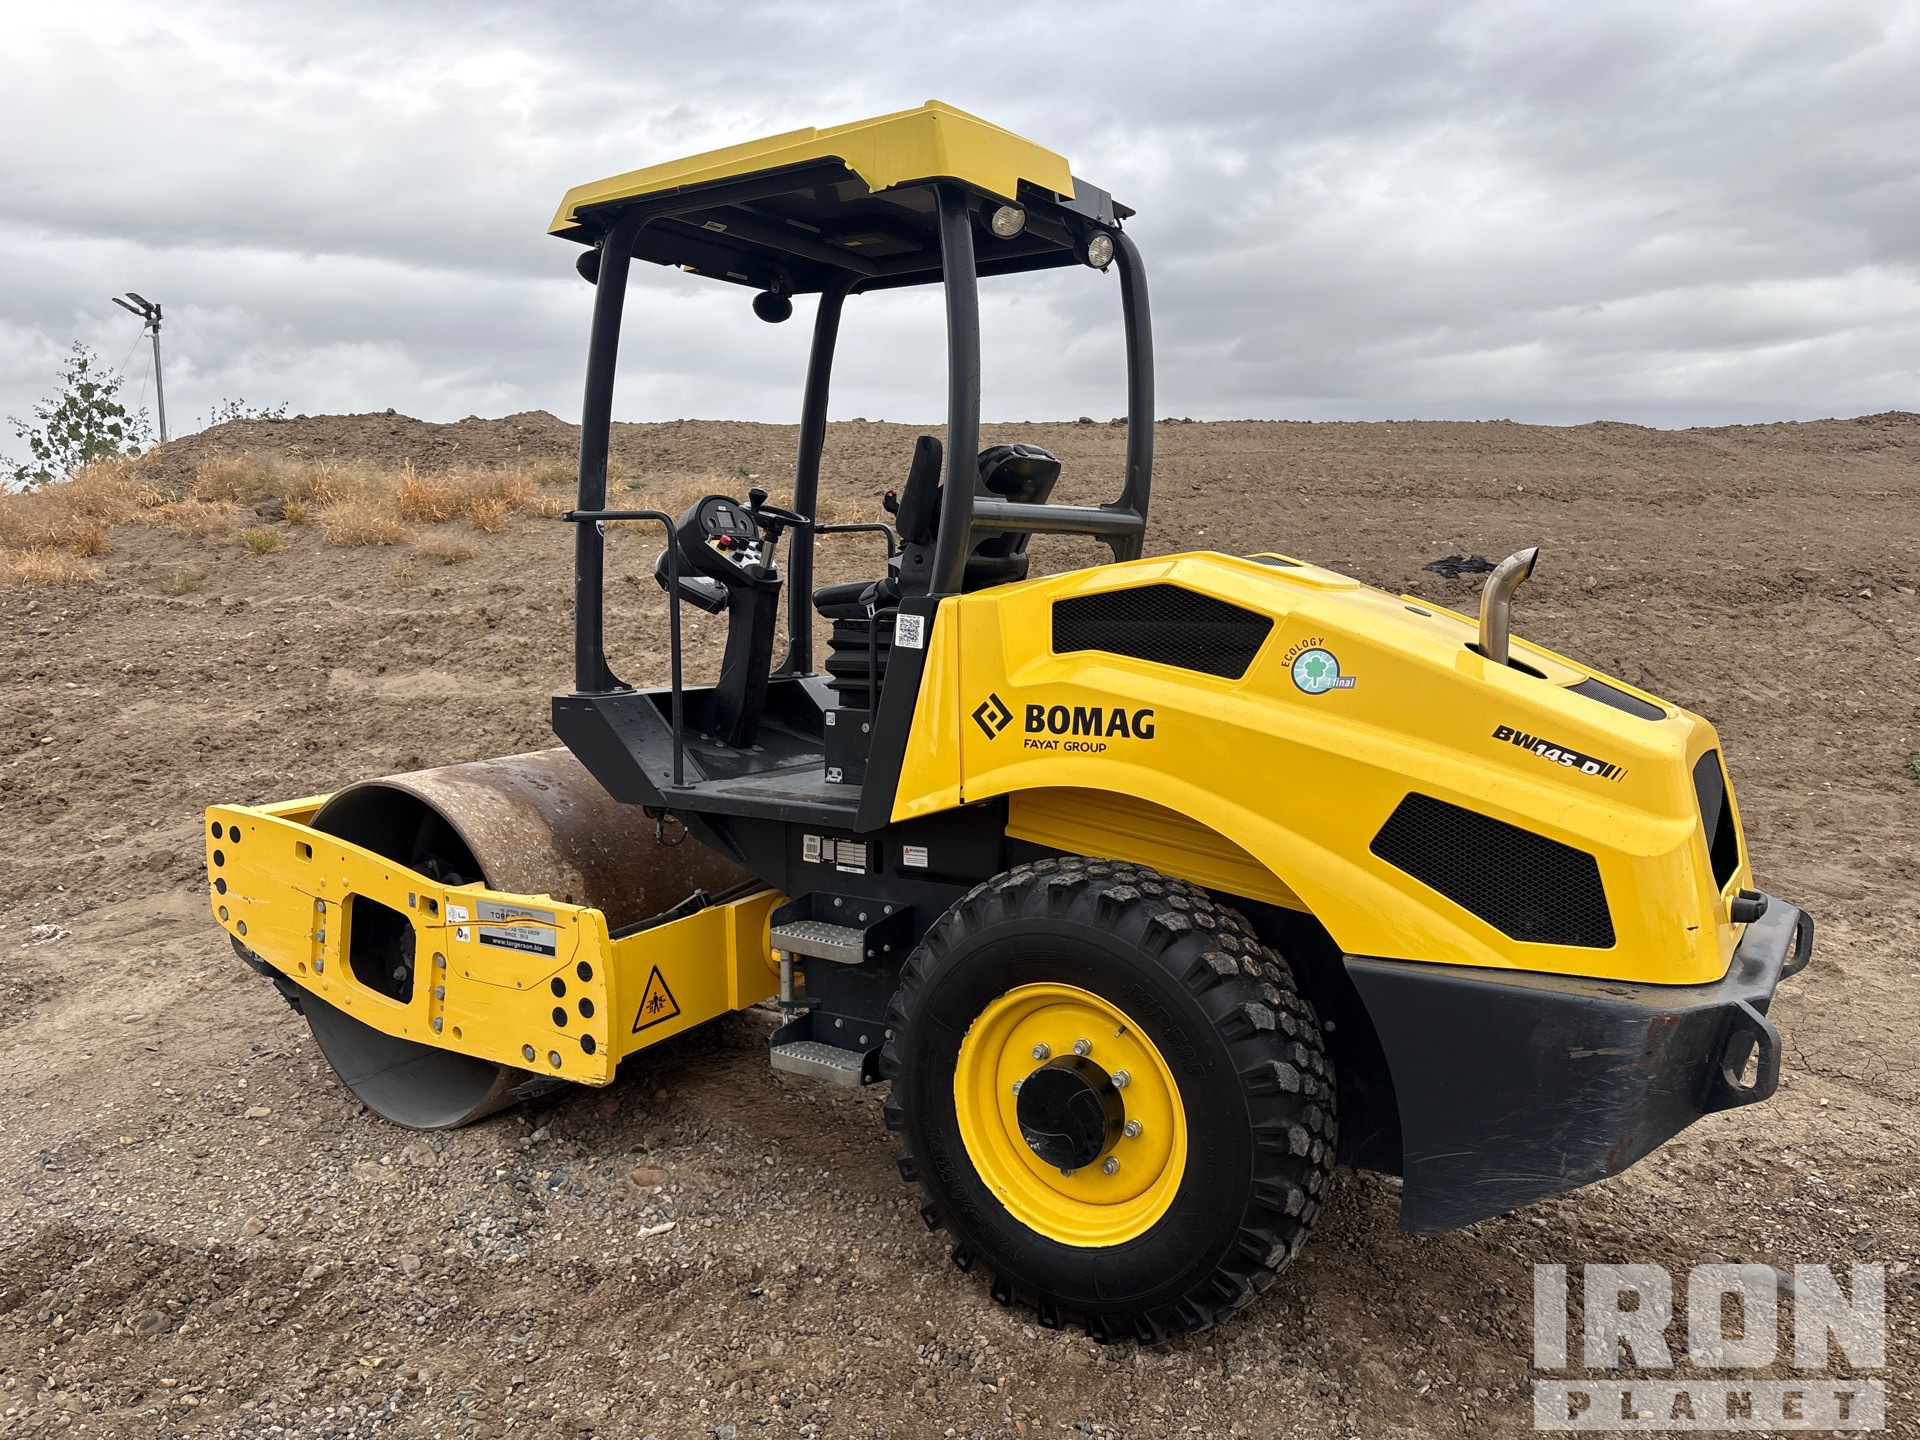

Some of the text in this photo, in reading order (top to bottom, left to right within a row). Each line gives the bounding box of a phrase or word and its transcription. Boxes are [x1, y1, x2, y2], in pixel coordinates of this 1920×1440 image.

[1281, 637, 1325, 668] ECOLOGY
[1024, 704, 1155, 740] BOMAG
[1024, 739, 1107, 753] FAYAT GROUP
[1579, 760, 1601, 776] D
[492, 938, 543, 952] www.torgerson.biz
